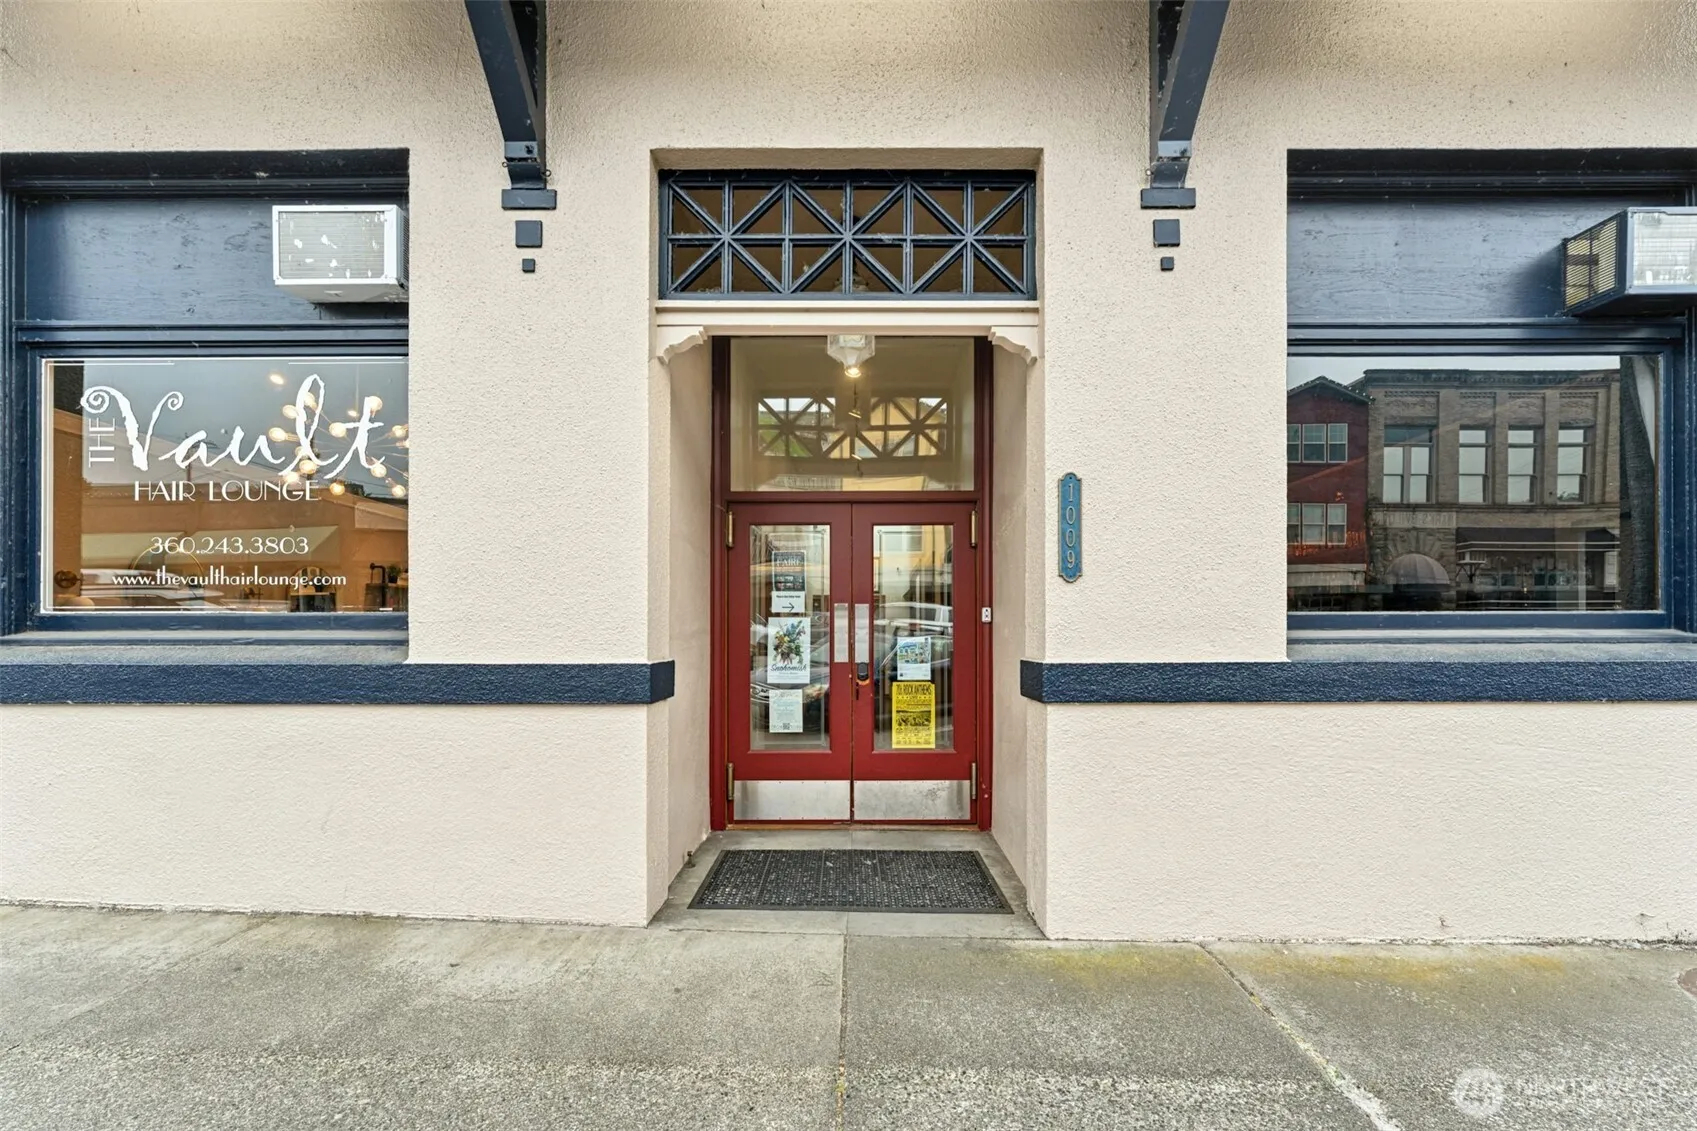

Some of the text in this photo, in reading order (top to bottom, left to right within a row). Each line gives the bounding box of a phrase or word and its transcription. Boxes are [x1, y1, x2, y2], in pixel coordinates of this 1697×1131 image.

[80, 374, 386, 479] Vault
[88, 417, 116, 468] THE
[134, 479, 320, 502] HAIR LOUNGE
[1065, 483, 1077, 569] 1009
[150, 536, 310, 554] 360.243.3803
[111, 565, 347, 590] www.thevaulthairlounge.com
[770, 663, 807, 673] Snohomish
[903, 684, 915, 695] ROCK
